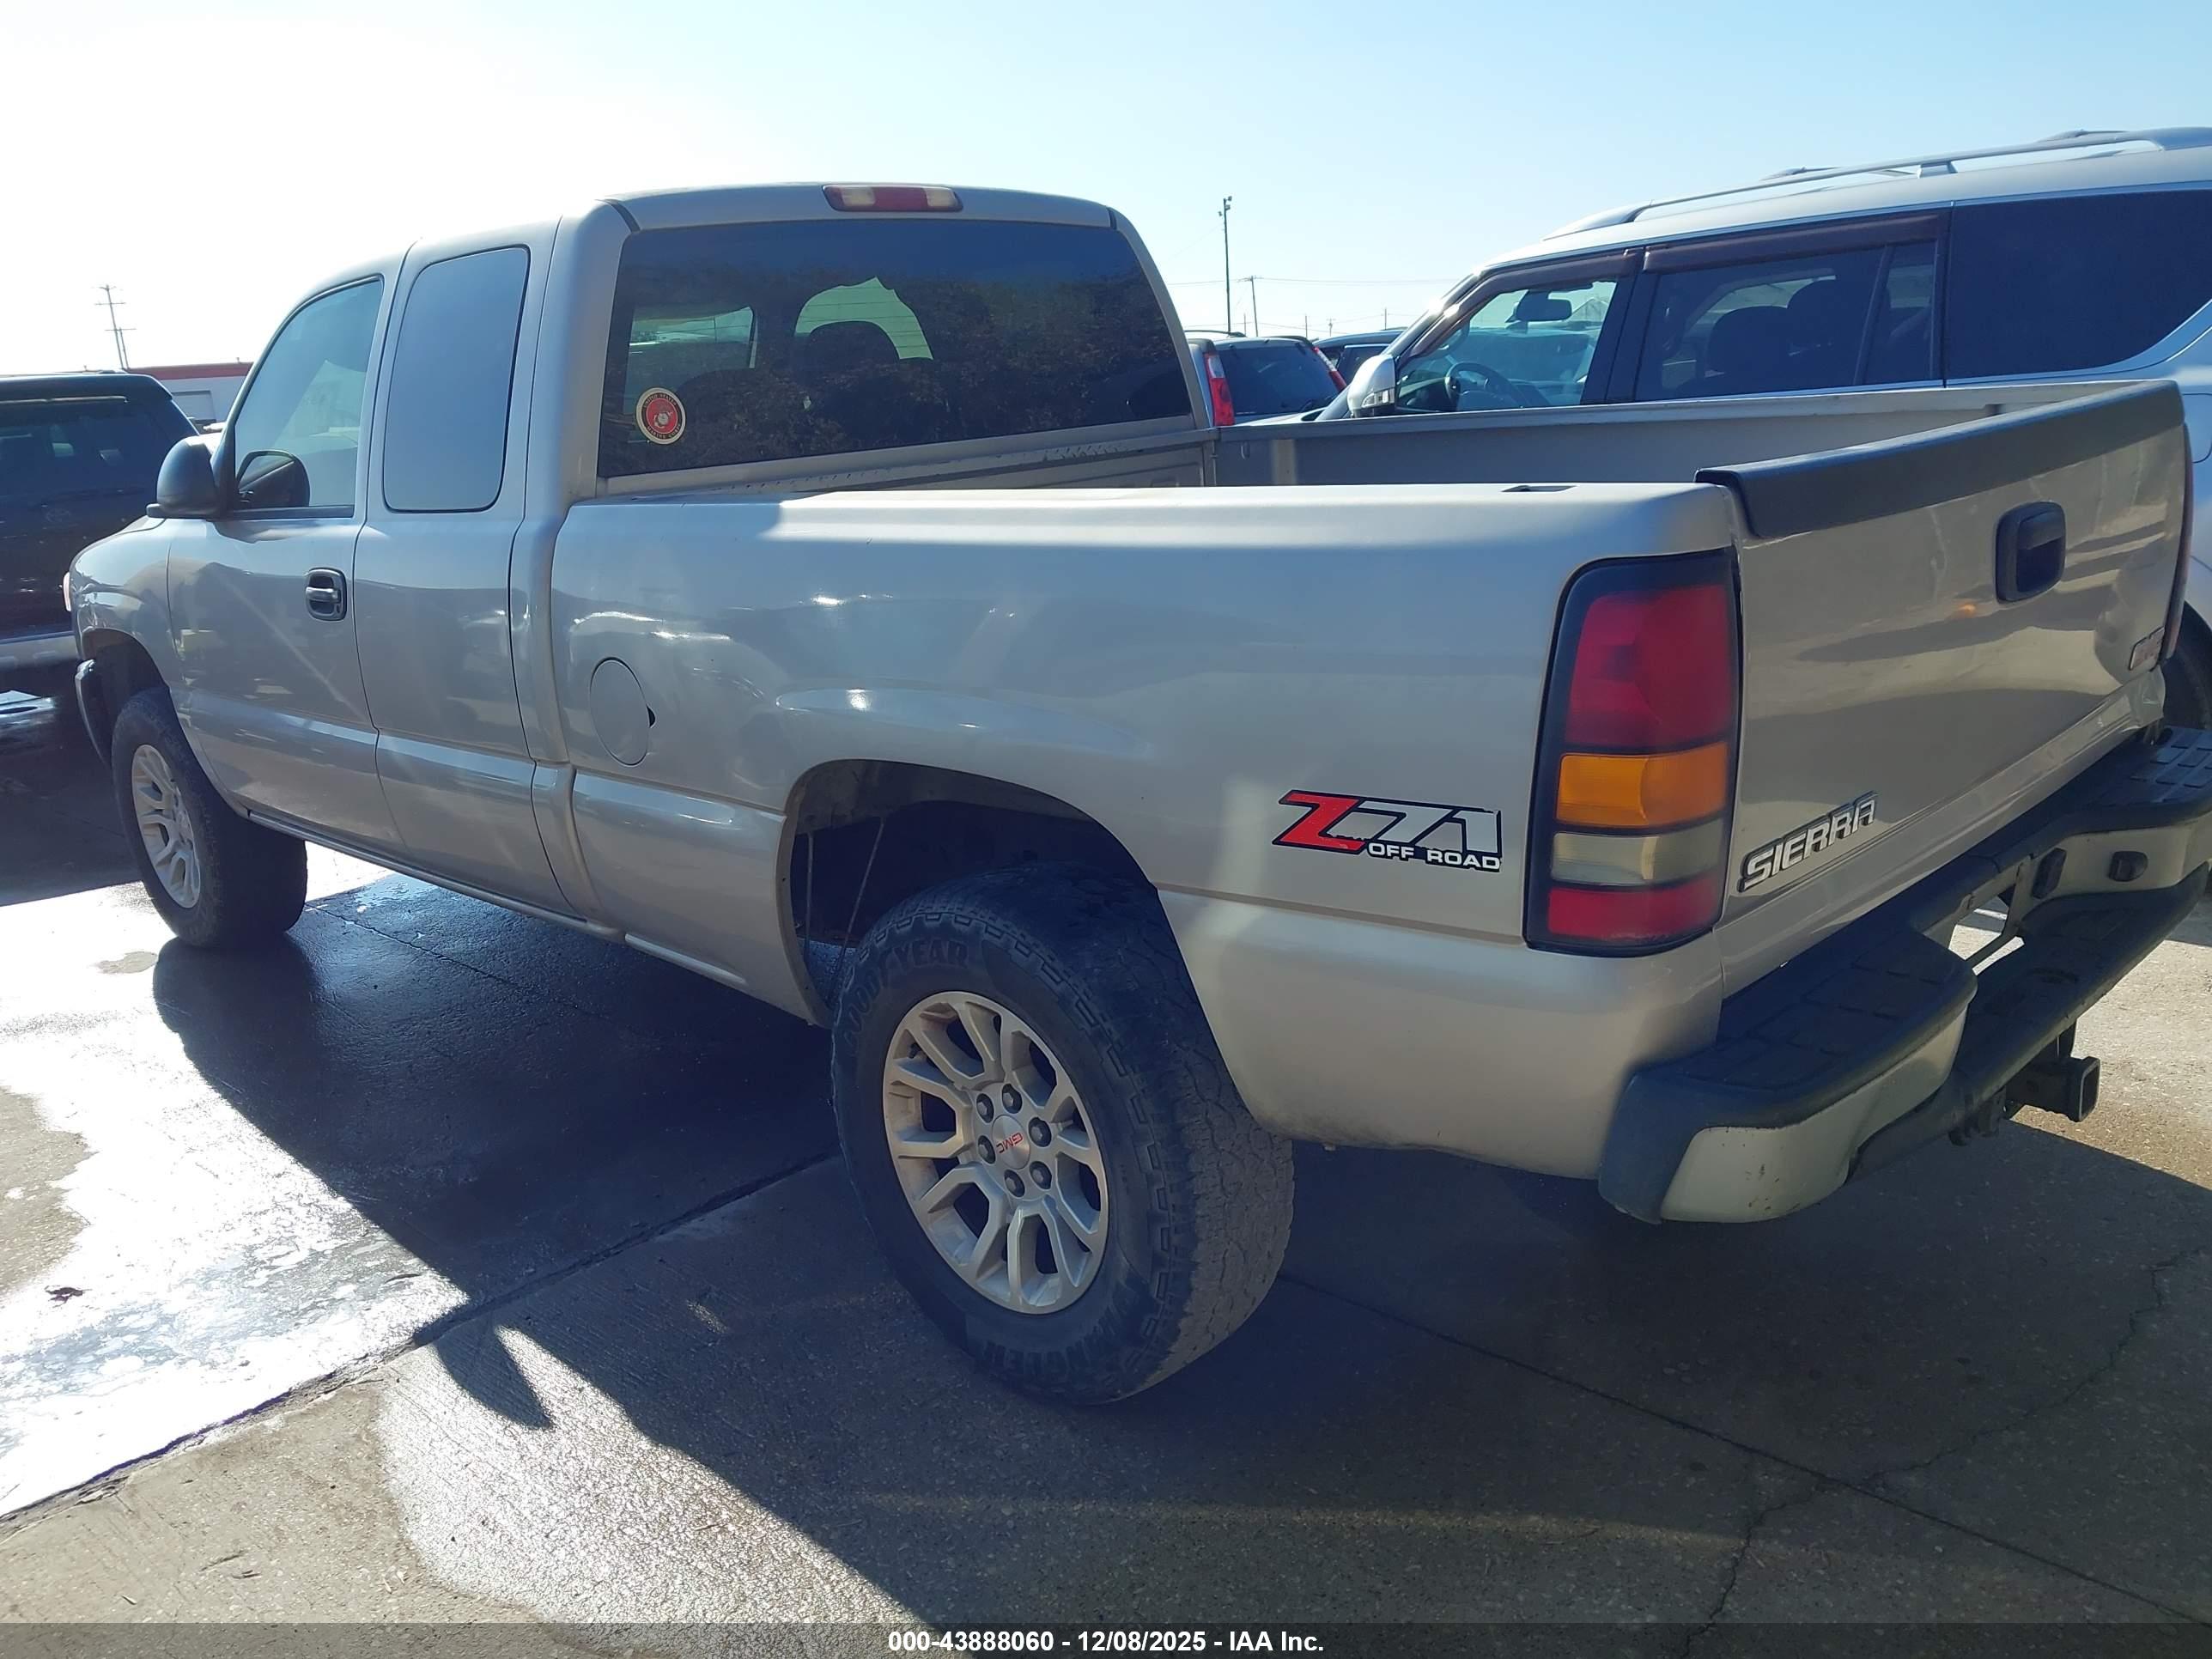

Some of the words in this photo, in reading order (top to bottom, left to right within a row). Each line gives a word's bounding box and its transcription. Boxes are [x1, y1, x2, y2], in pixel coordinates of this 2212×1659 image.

[1272, 789, 1502, 859] Z71
[1738, 792, 1877, 892] SIERRA
[1367, 842, 1414, 860] OFF
[1425, 848, 1501, 870] ROAD
[996, 1133, 1024, 1154] GMC
